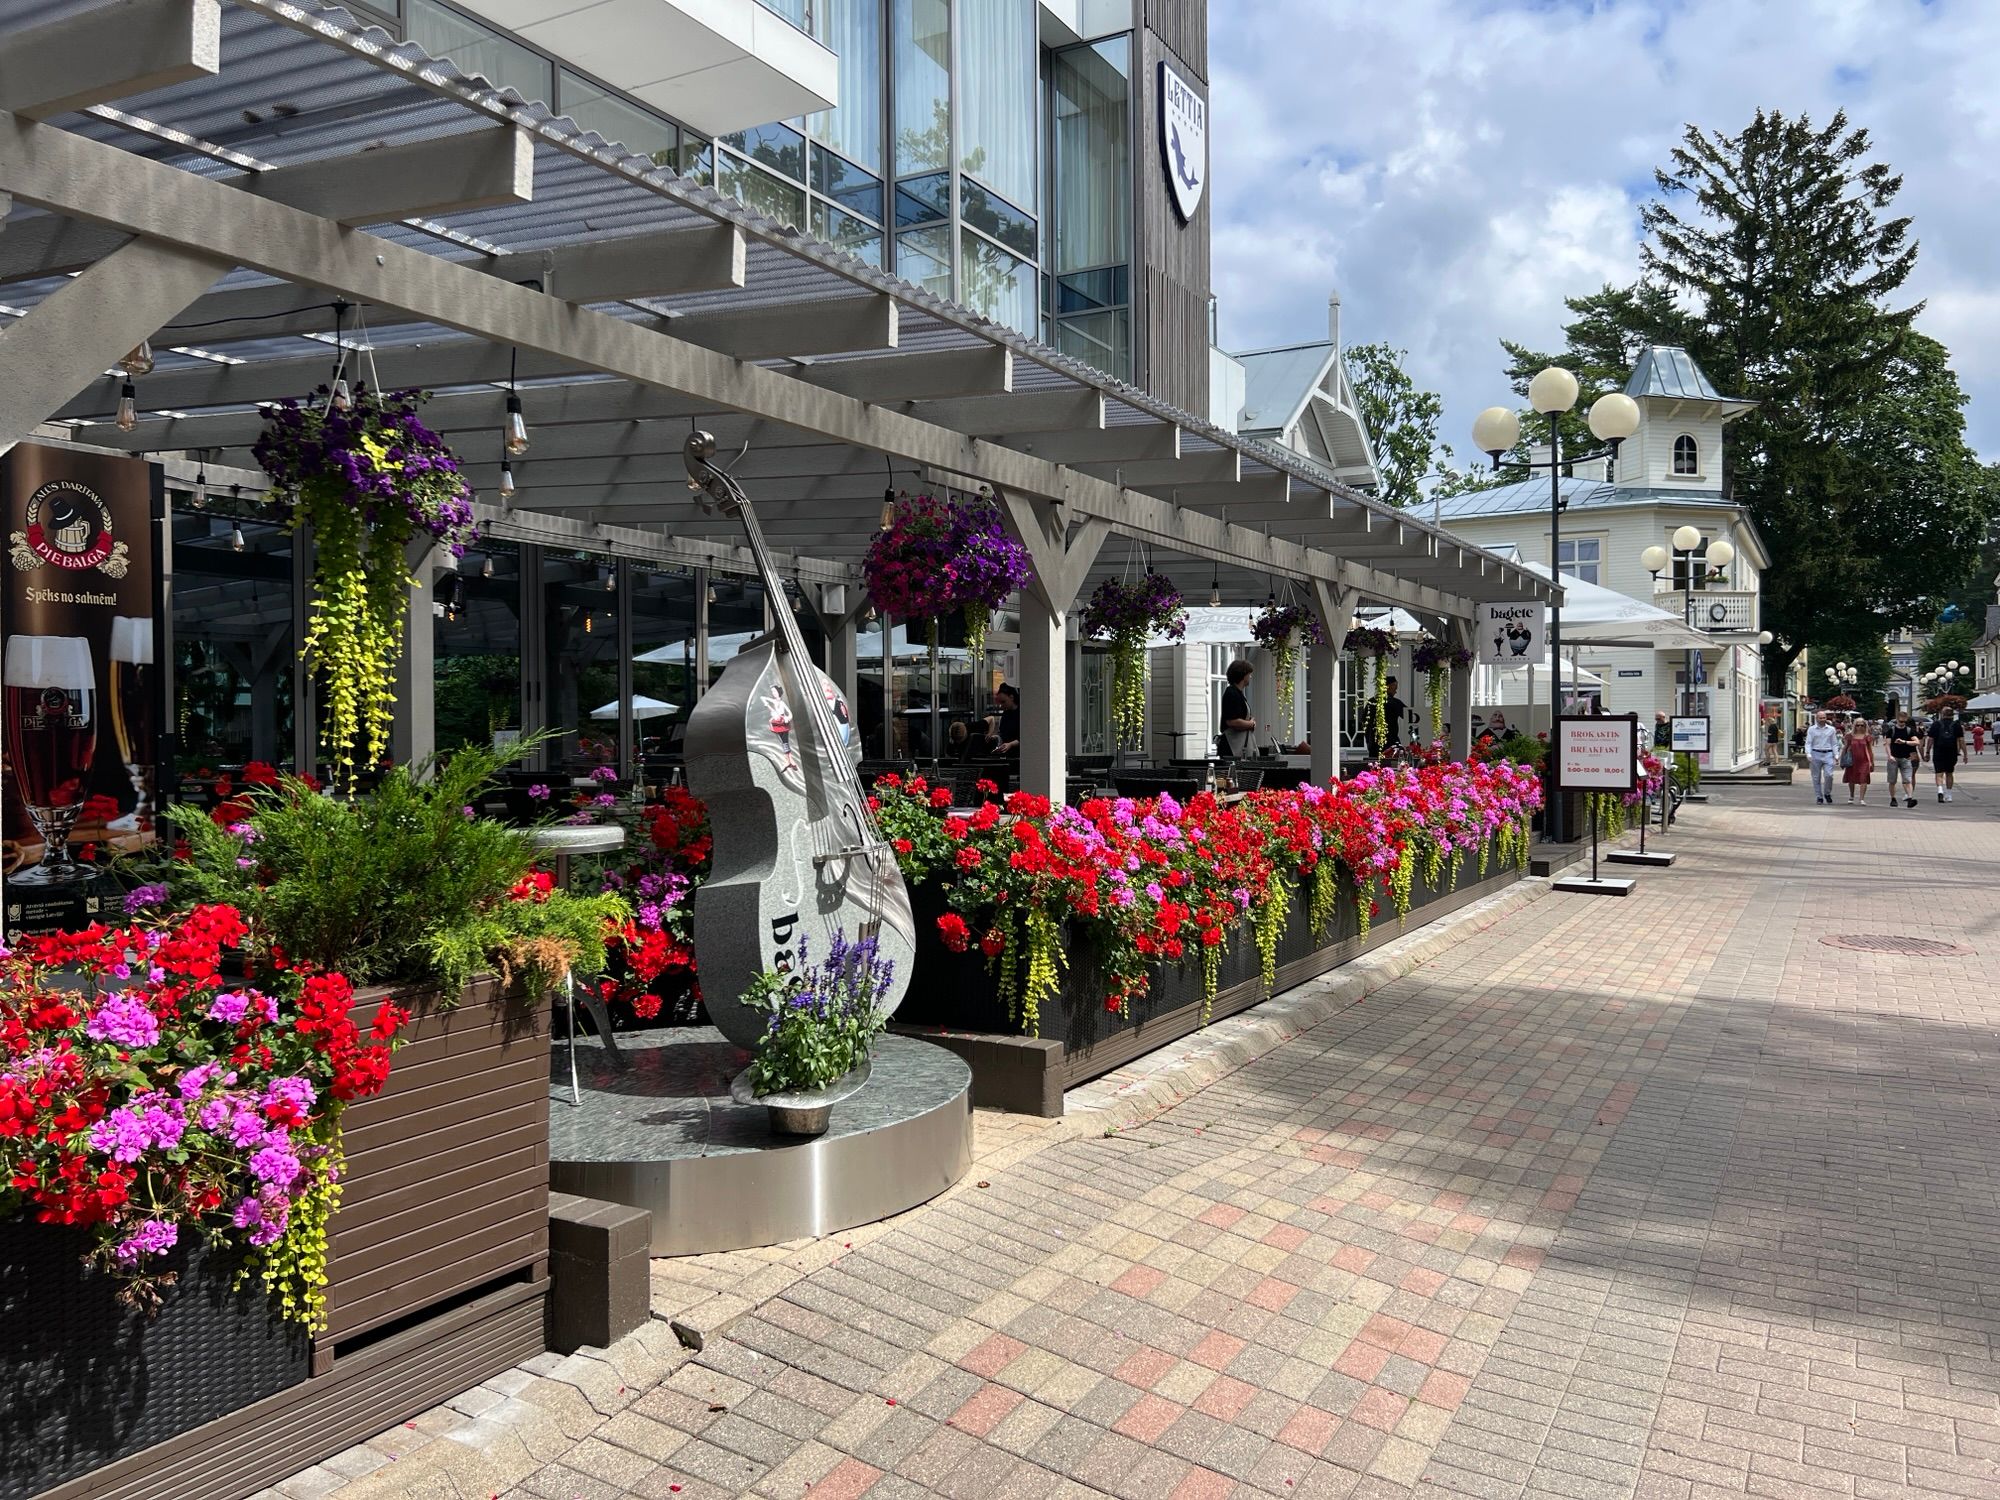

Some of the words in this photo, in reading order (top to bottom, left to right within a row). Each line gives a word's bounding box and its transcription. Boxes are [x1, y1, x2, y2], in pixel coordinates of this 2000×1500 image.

[1168, 73, 1203, 130] LETTIA
[37, 482, 59, 502] ALUS
[36, 542, 107, 568] PIEBALGA
[25, 586, 60, 604] Spēks
[61, 593, 73, 603] no
[75, 591, 117, 606] saknēm!
[1490, 607, 1534, 622] bagete
